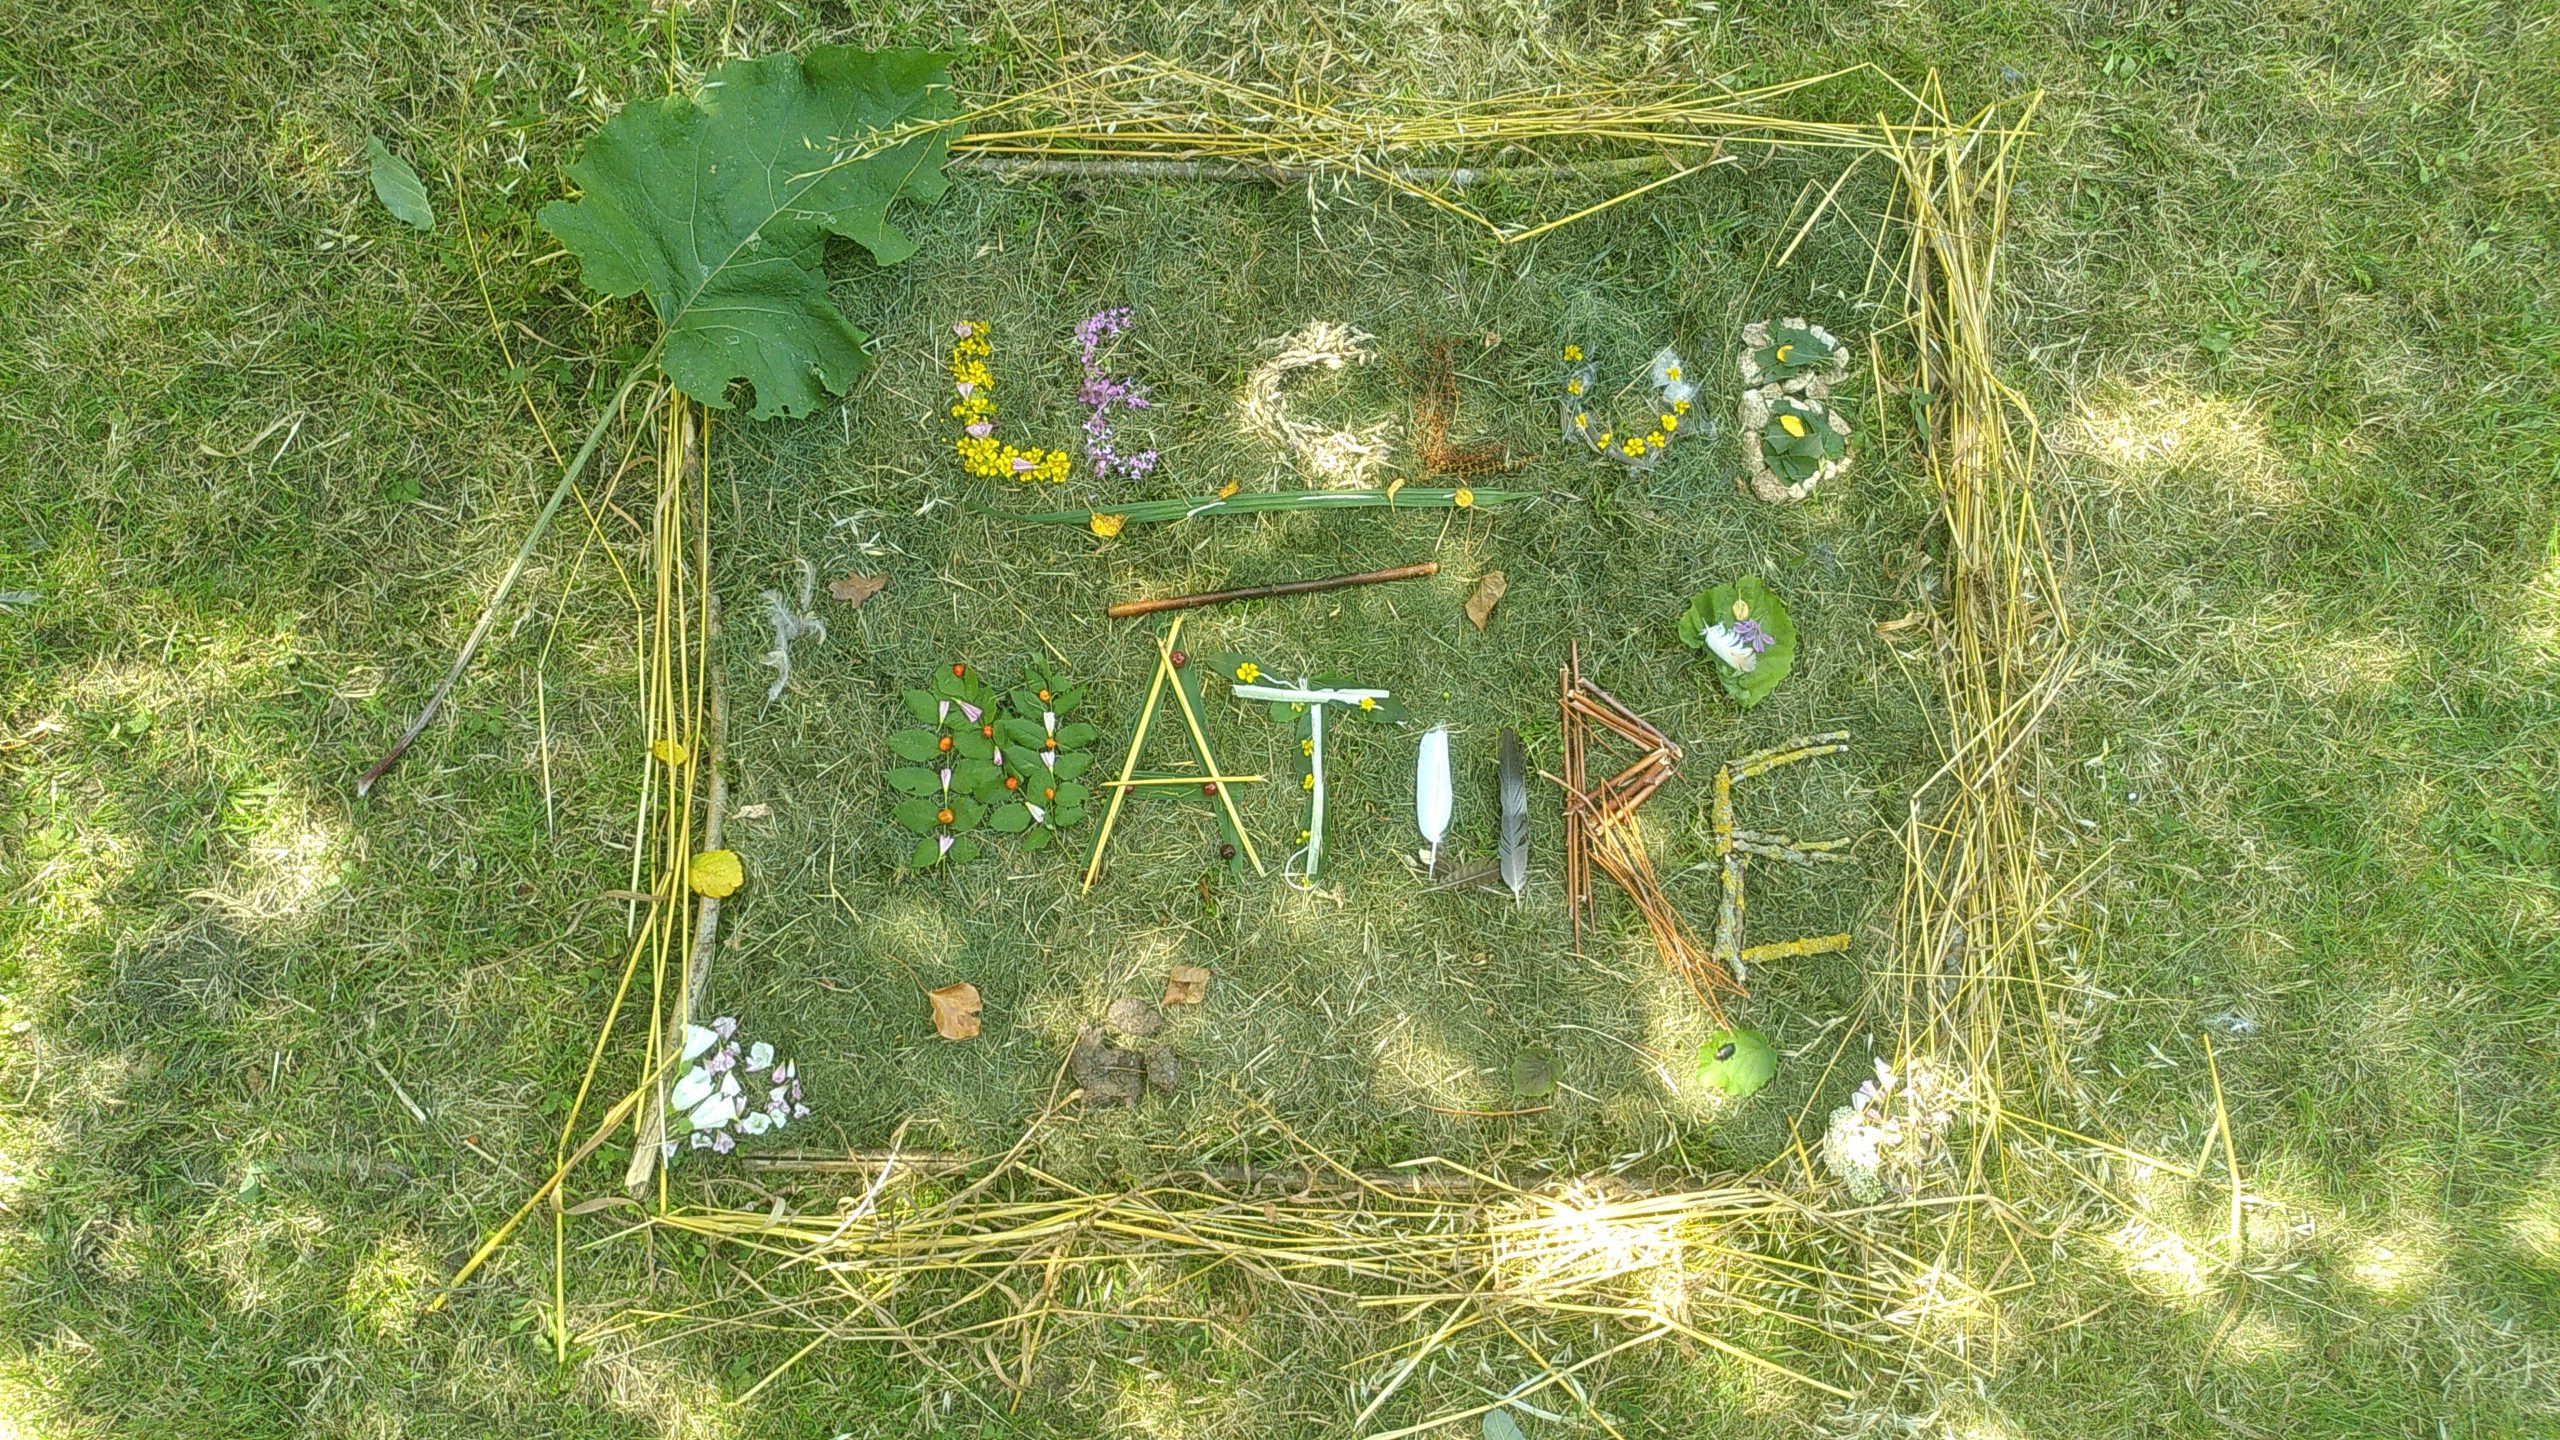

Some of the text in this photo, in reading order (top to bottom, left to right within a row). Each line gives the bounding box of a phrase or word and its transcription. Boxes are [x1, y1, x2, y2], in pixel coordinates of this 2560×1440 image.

[951, 306, 1855, 505] LE CLUB
[885, 615, 1855, 1022] NATURE
